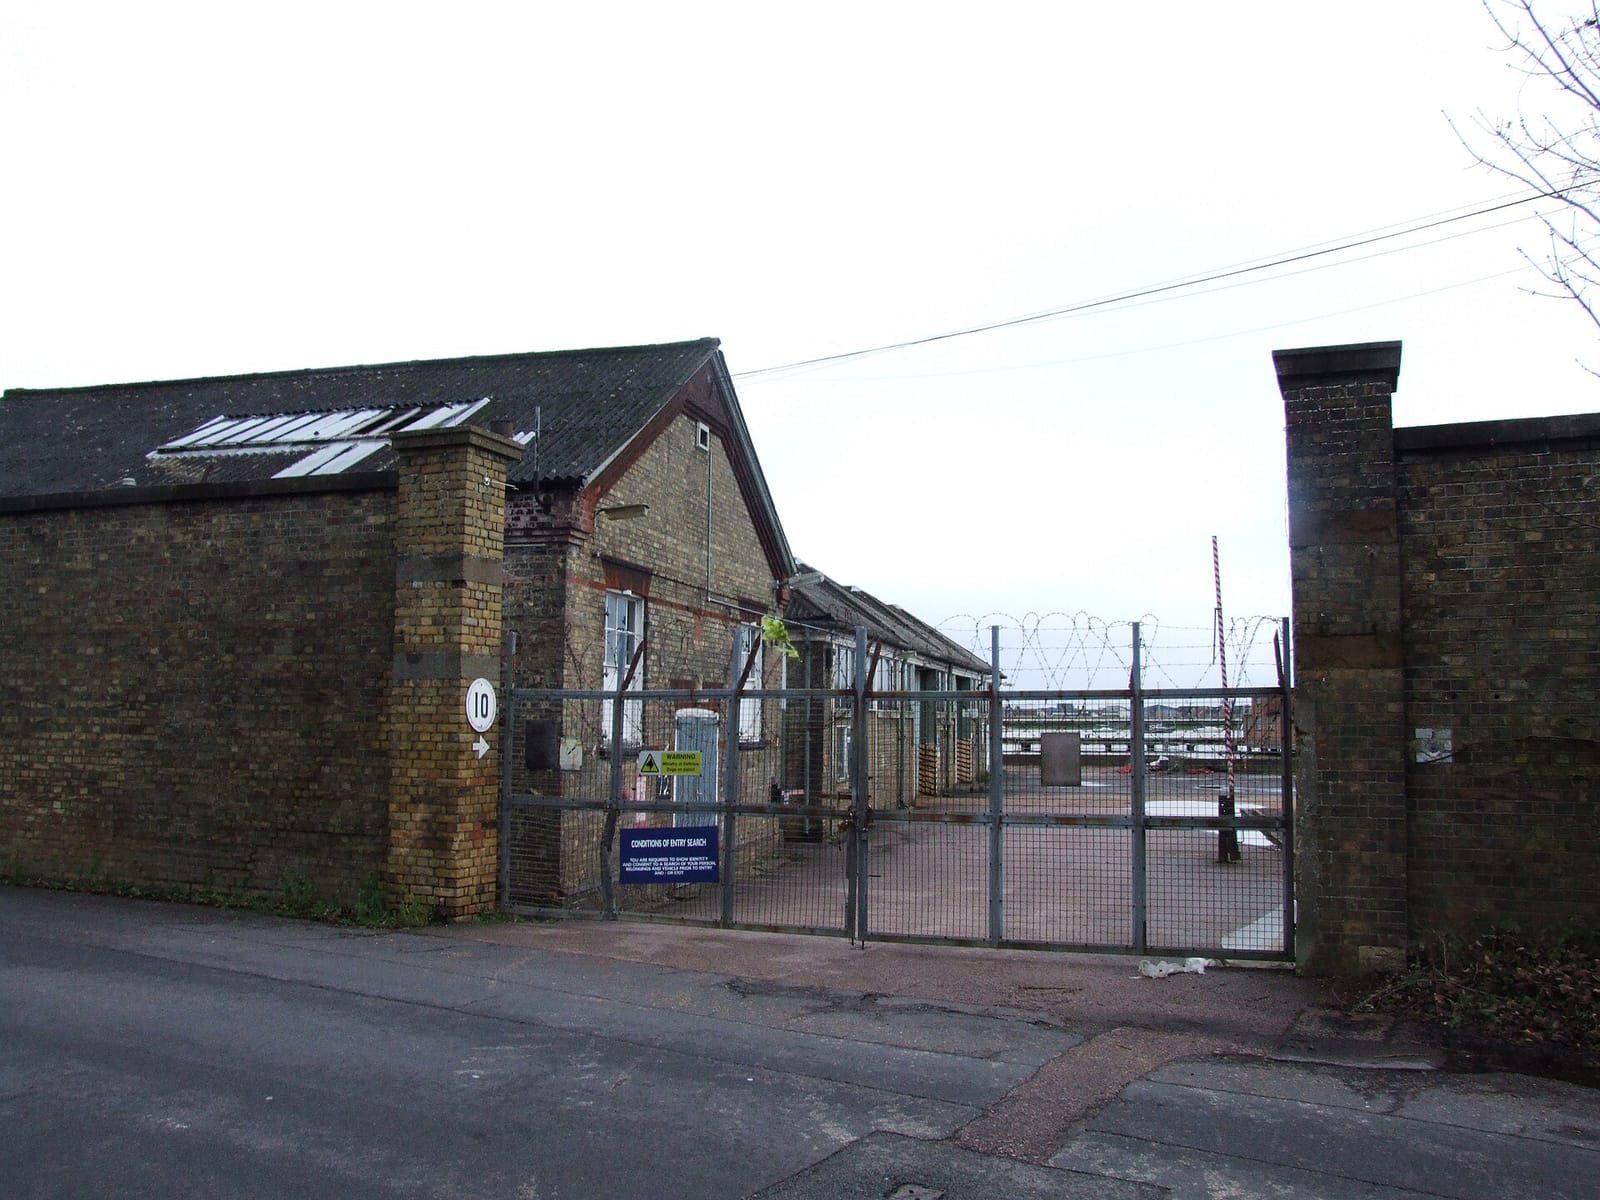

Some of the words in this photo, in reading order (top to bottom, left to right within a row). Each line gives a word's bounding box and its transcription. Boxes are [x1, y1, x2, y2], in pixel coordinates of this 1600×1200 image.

[475, 692, 488, 718] 10
[631, 840, 661, 848] CONDITIONS
[670, 839, 686, 847] ENTRY
[687, 838, 706, 846] SEARCH
